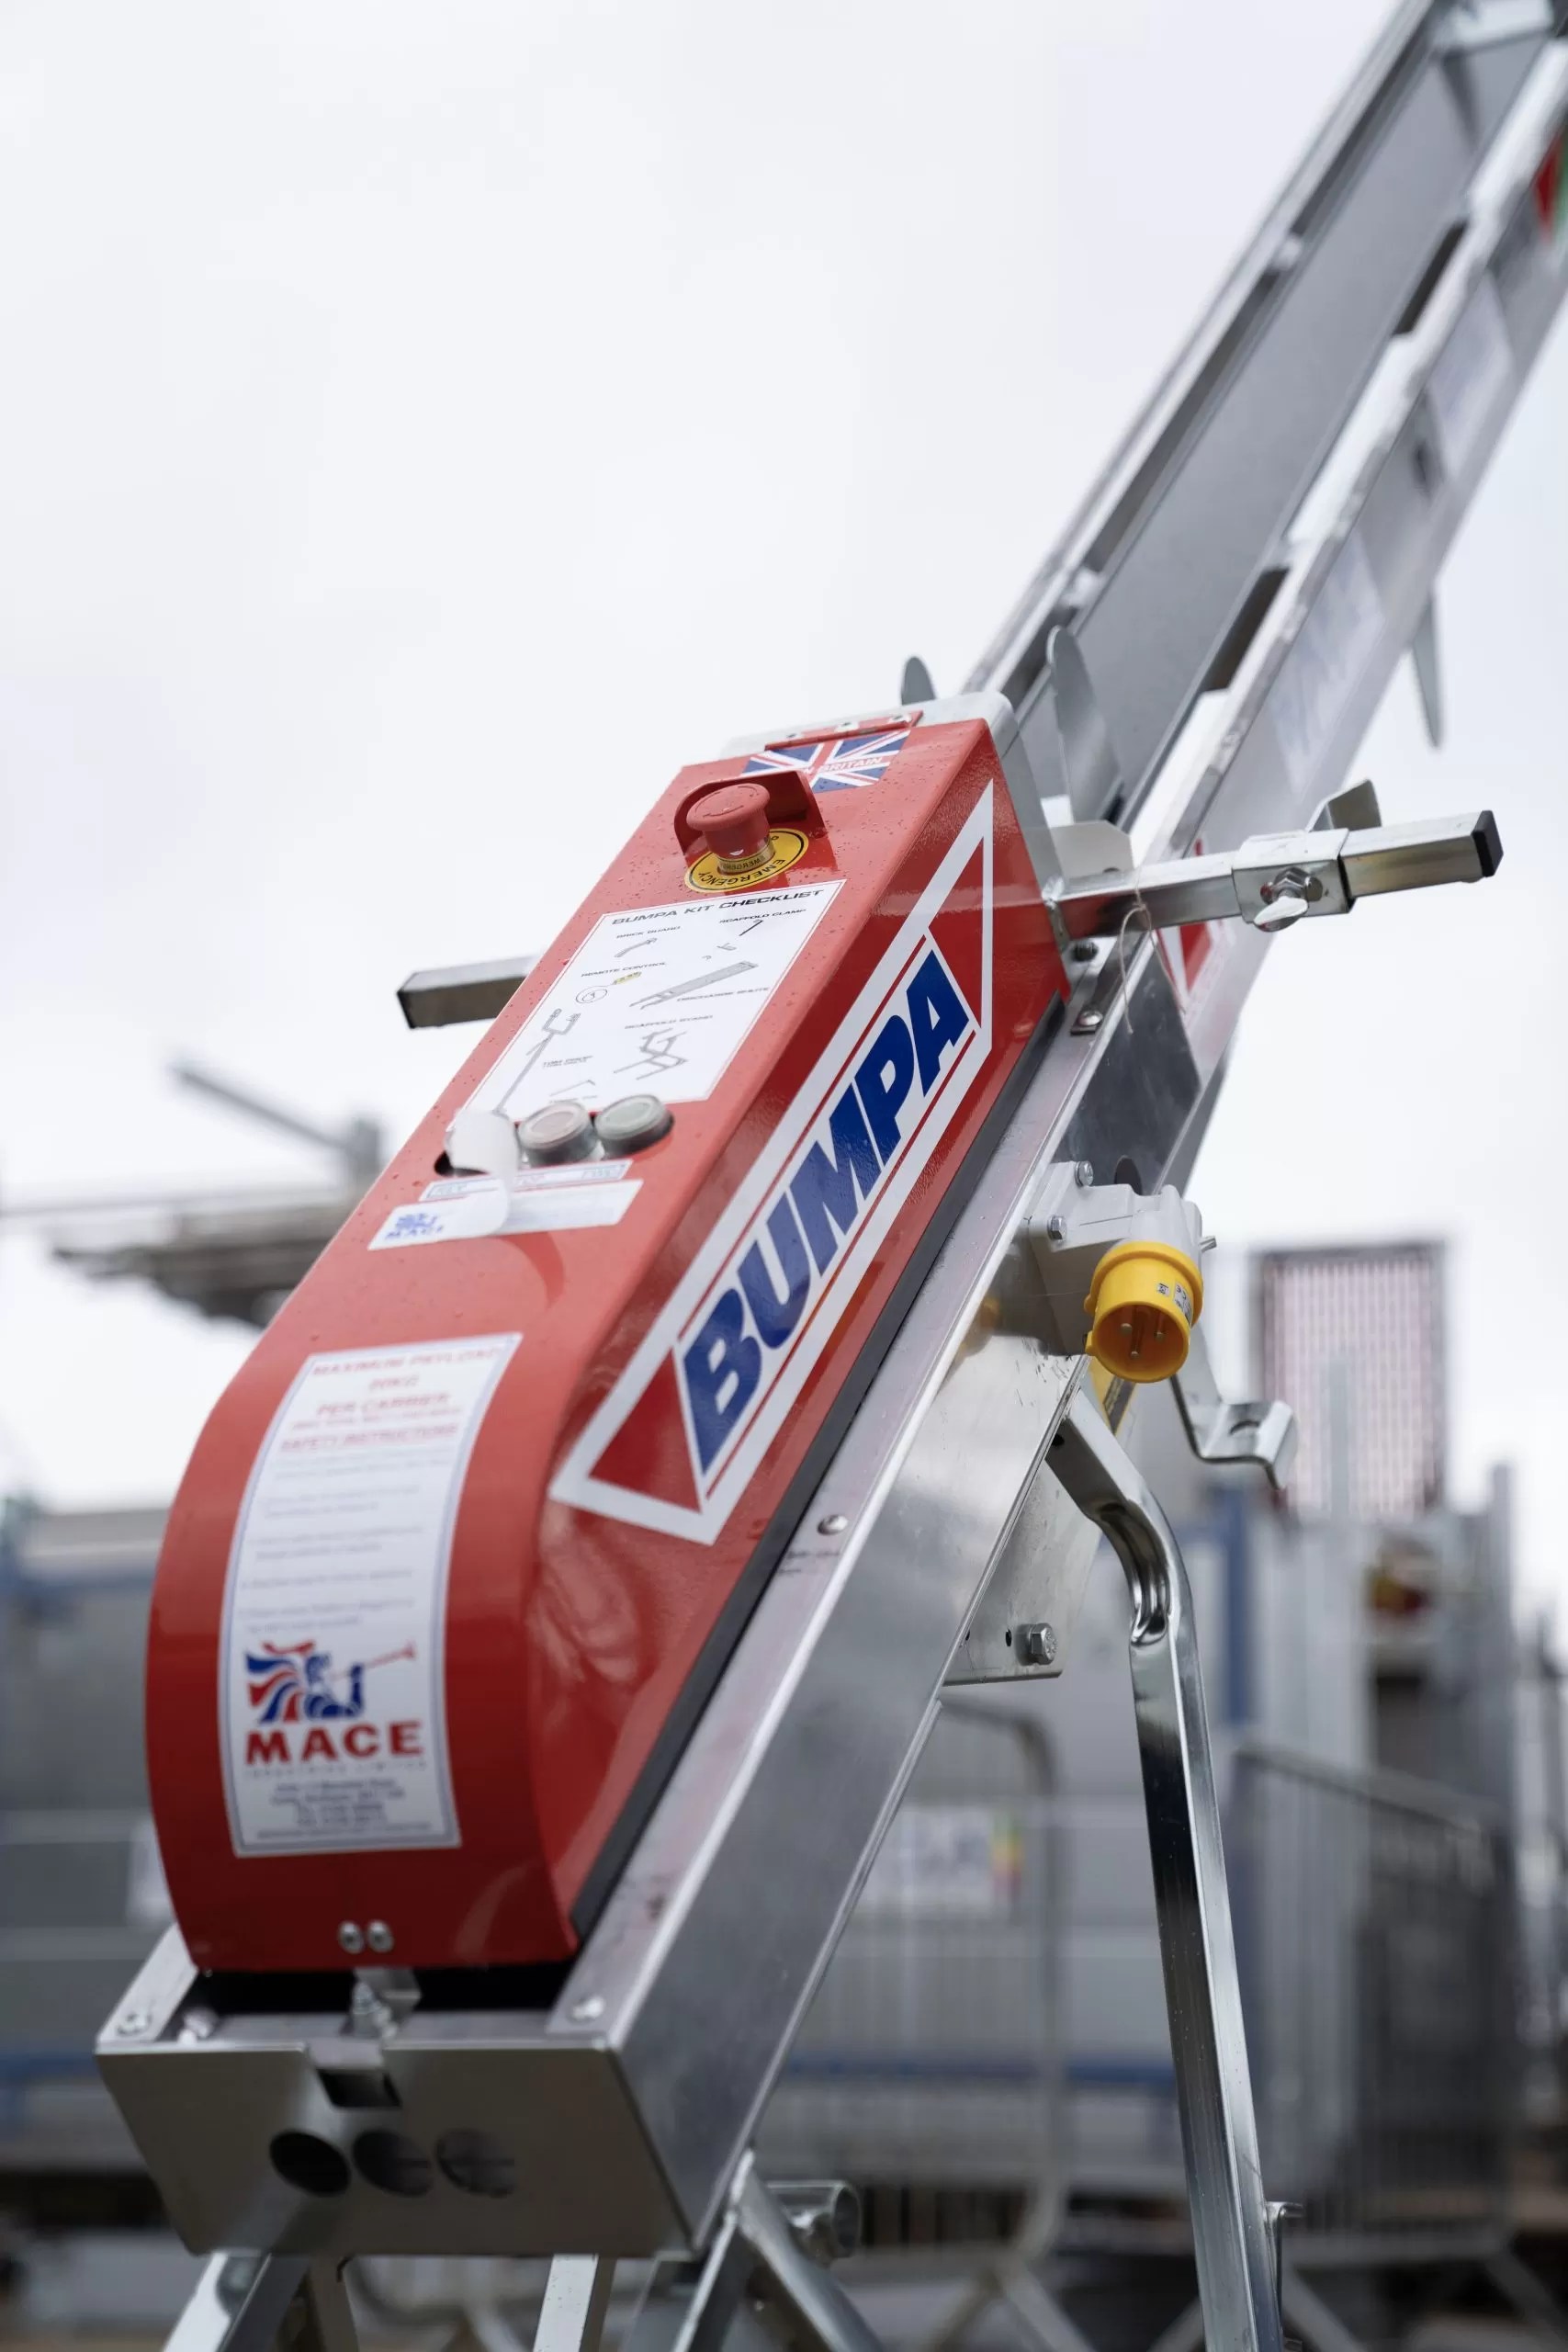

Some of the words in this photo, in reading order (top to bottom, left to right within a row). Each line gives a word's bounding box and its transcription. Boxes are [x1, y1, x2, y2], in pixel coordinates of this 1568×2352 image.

[821, 755, 883, 773] BRITAIN
[698, 859, 785, 886] EMERGENCY
[612, 910, 677, 924] BUMPA
[684, 904, 715, 914] KIT
[719, 889, 824, 909] CHECKLIST
[719, 913, 769, 923] SCAFFOLD
[772, 909, 807, 917] CLAMP
[622, 962, 666, 971] CONTROL
[682, 948, 975, 1476] BUMPA
[245, 1719, 423, 1765] MACE
